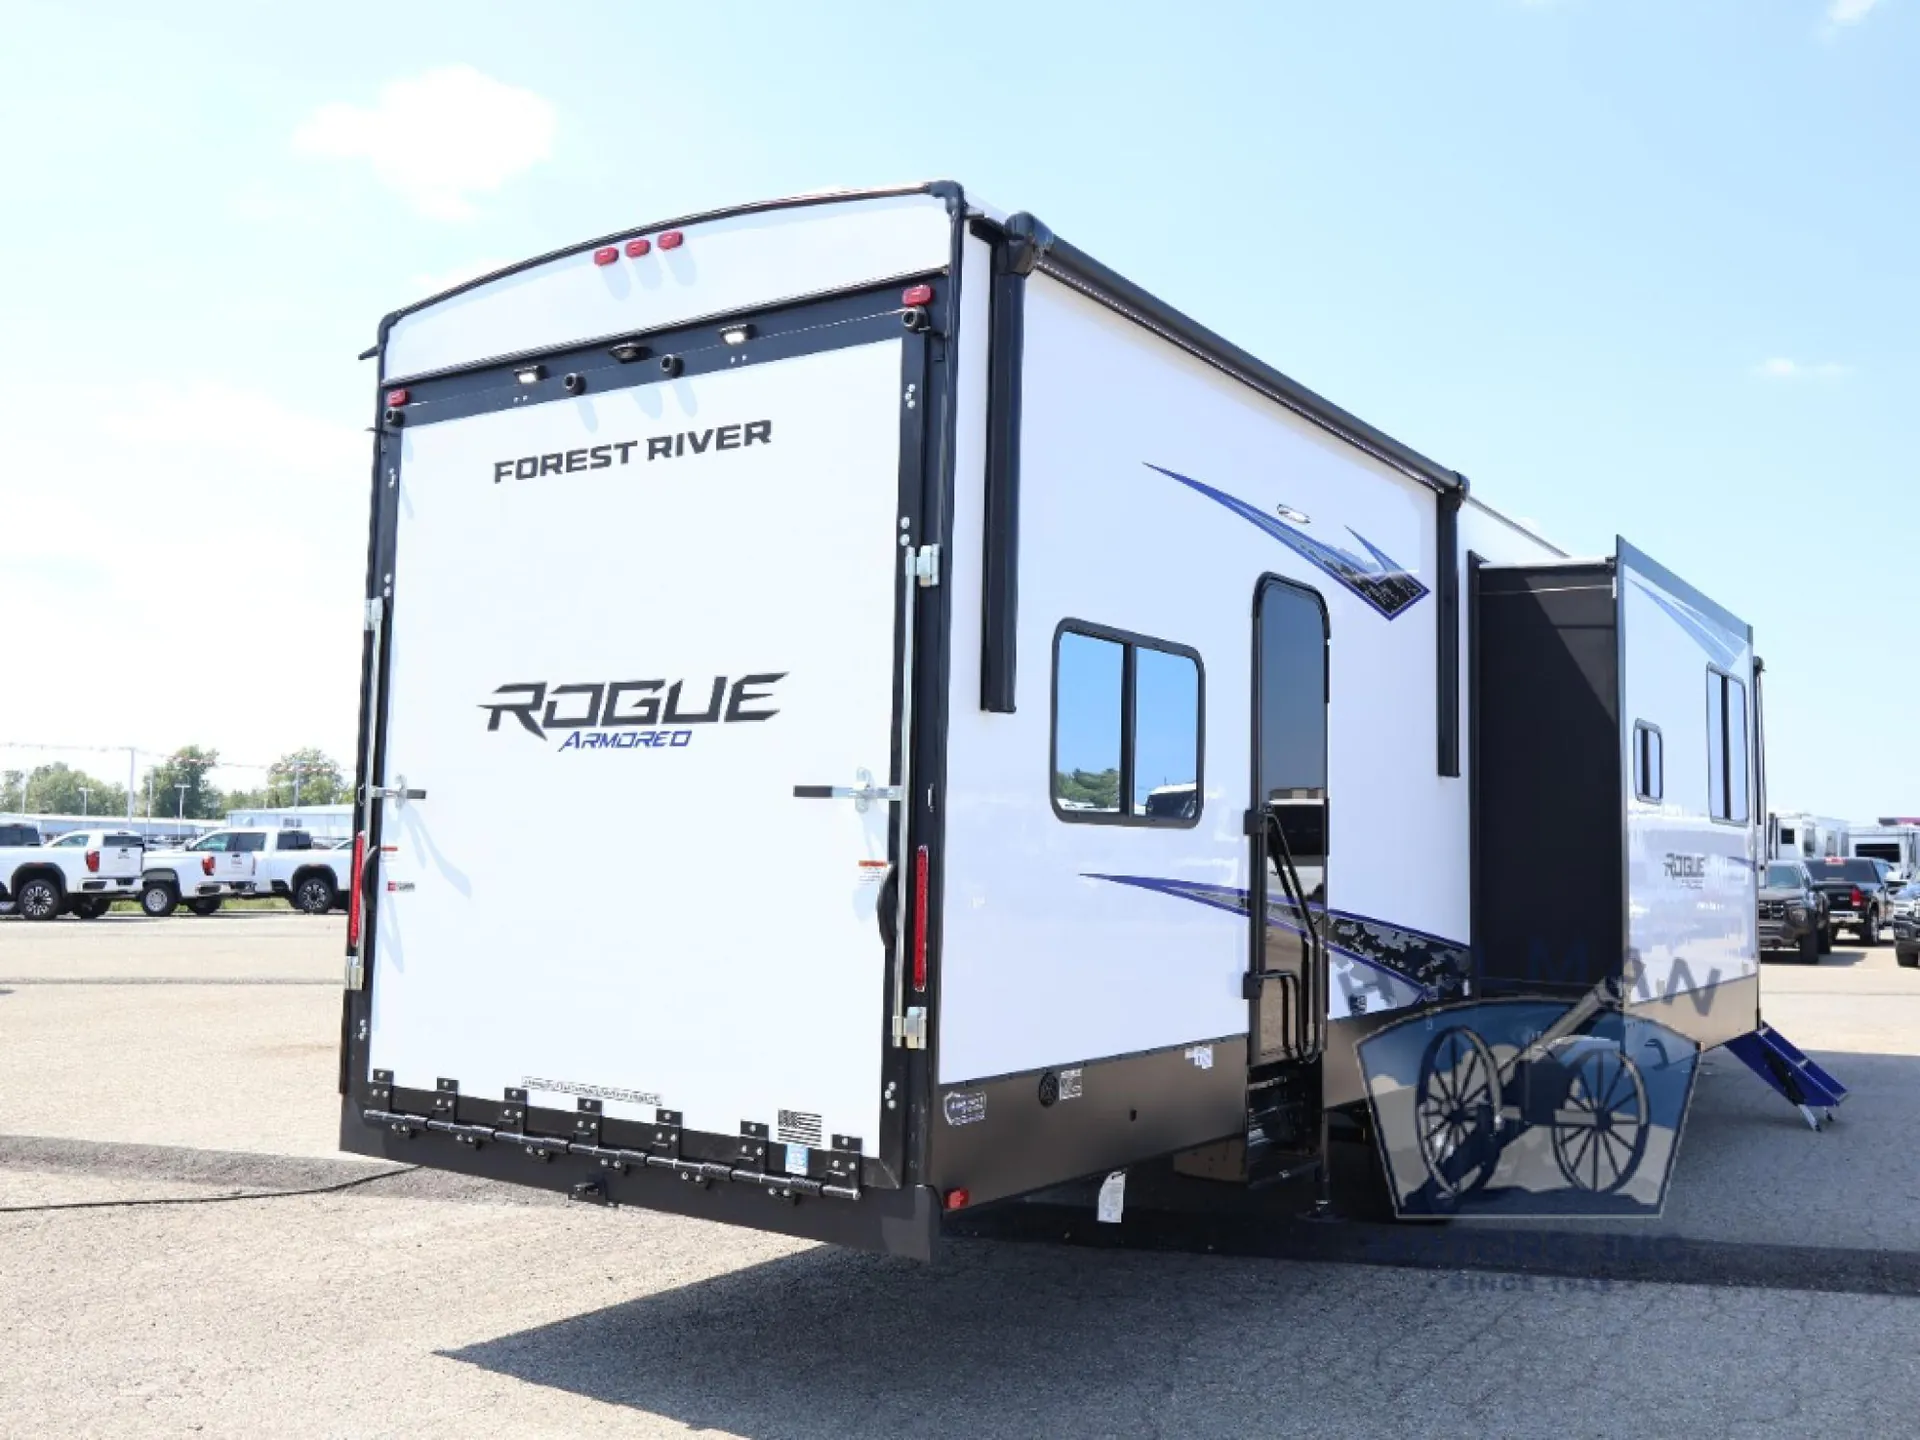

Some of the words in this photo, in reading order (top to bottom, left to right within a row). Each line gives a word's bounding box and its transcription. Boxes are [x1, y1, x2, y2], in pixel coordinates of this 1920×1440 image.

[494, 440, 639, 484] FOREST
[647, 419, 773, 461] RIVER
[476, 671, 790, 742] ROGUE
[557, 730, 693, 753] ARMORED
